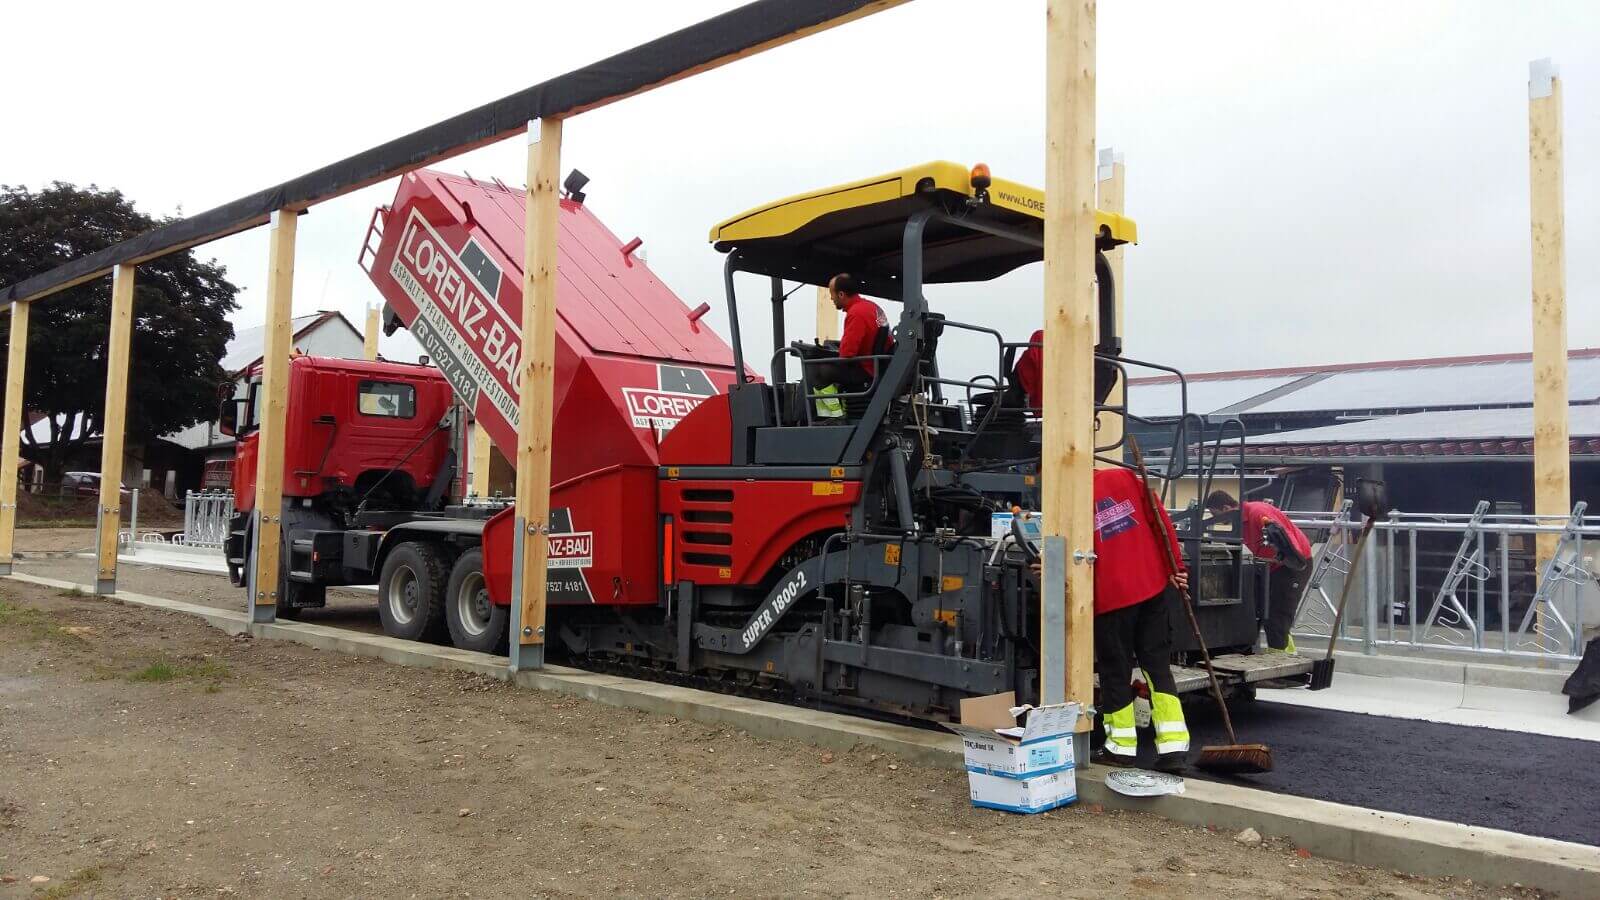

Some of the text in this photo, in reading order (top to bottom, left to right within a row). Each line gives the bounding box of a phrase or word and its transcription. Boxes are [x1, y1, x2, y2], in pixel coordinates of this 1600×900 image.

[392, 262, 422, 299] ASPHALT
[424, 301, 458, 346] PFLASTER
[426, 332, 476, 401] 07527 4181
[630, 393, 703, 417] LOREN
[564, 581, 583, 592] 4181
[742, 571, 807, 648] SUPER 1800-2
